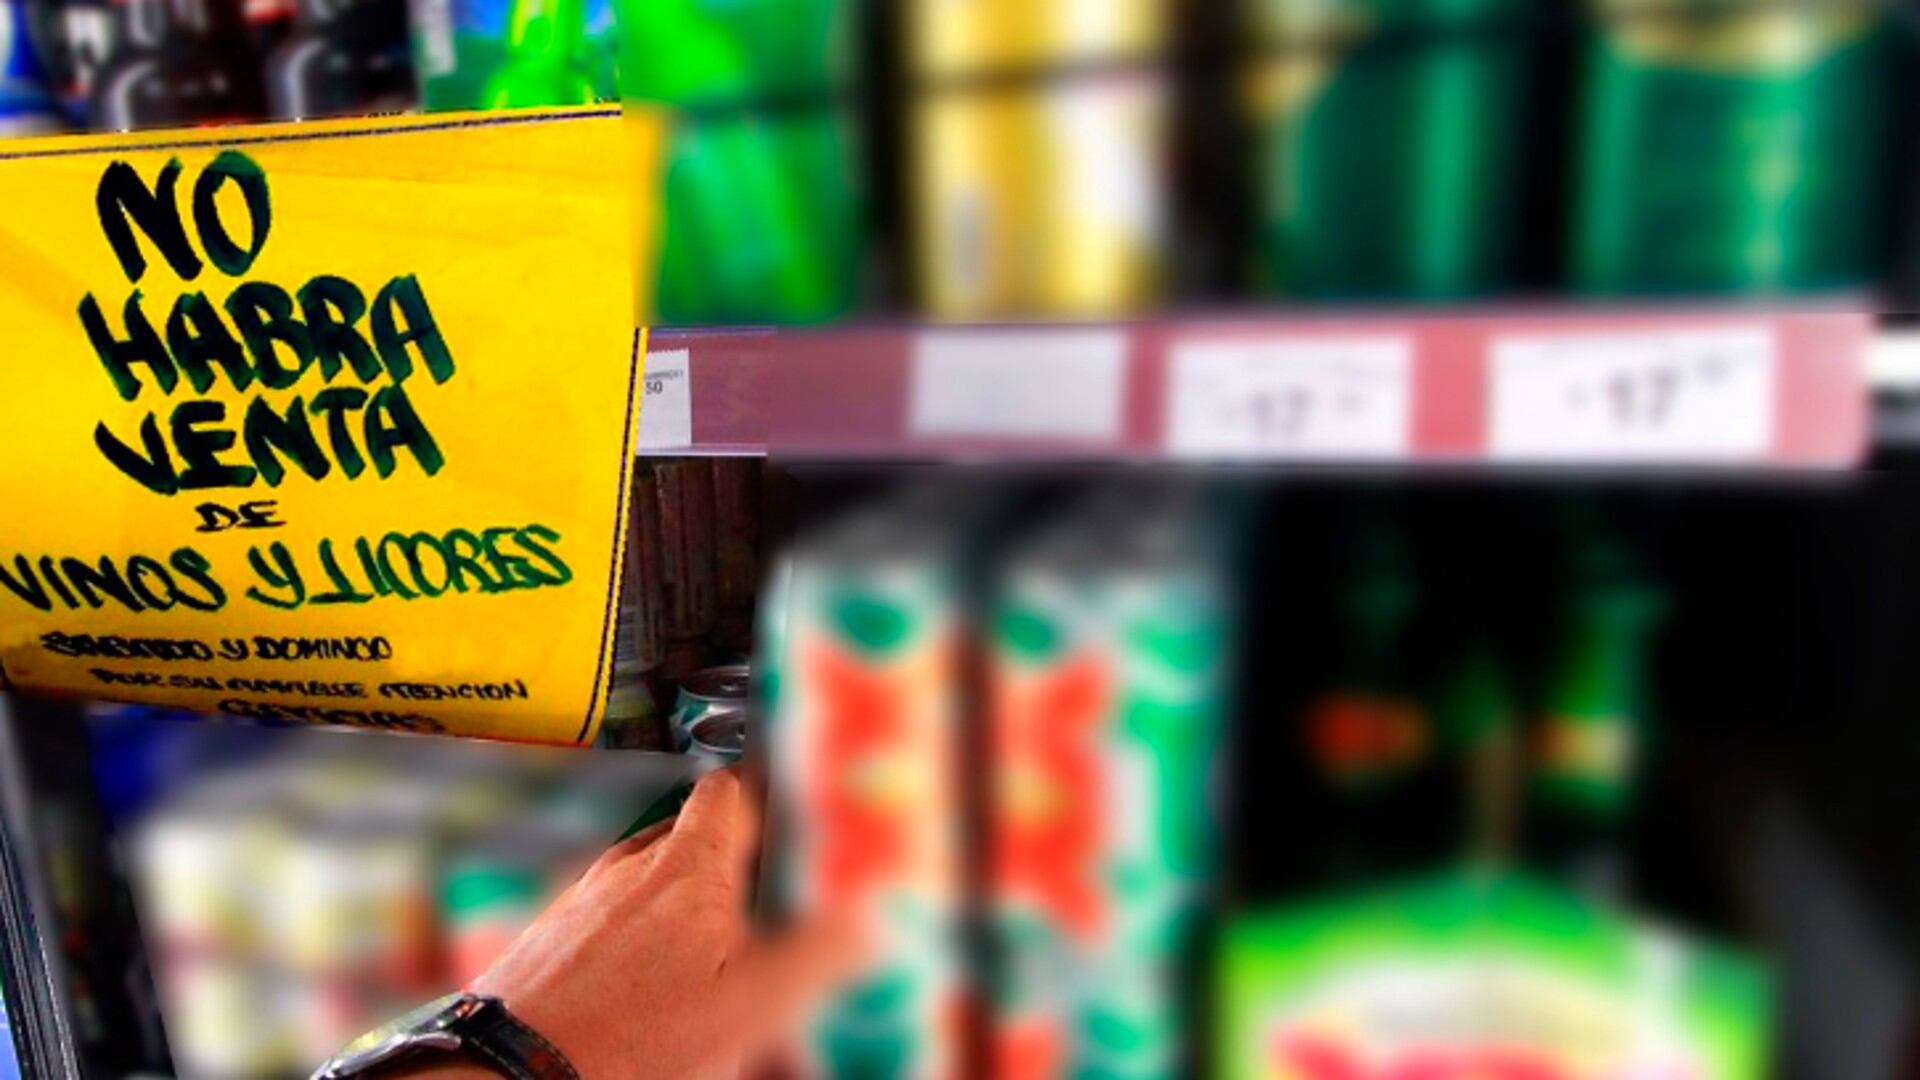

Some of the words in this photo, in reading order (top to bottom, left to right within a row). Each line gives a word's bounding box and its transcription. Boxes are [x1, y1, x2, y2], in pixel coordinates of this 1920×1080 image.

[96, 150, 271, 283] NO
[78, 273, 456, 401] HABRA
[94, 386, 445, 496] VENTA
[0, 547, 227, 612] VINOS
[246, 541, 305, 610] Y
[307, 524, 573, 604] LICORES
[195, 500, 287, 532] DE
